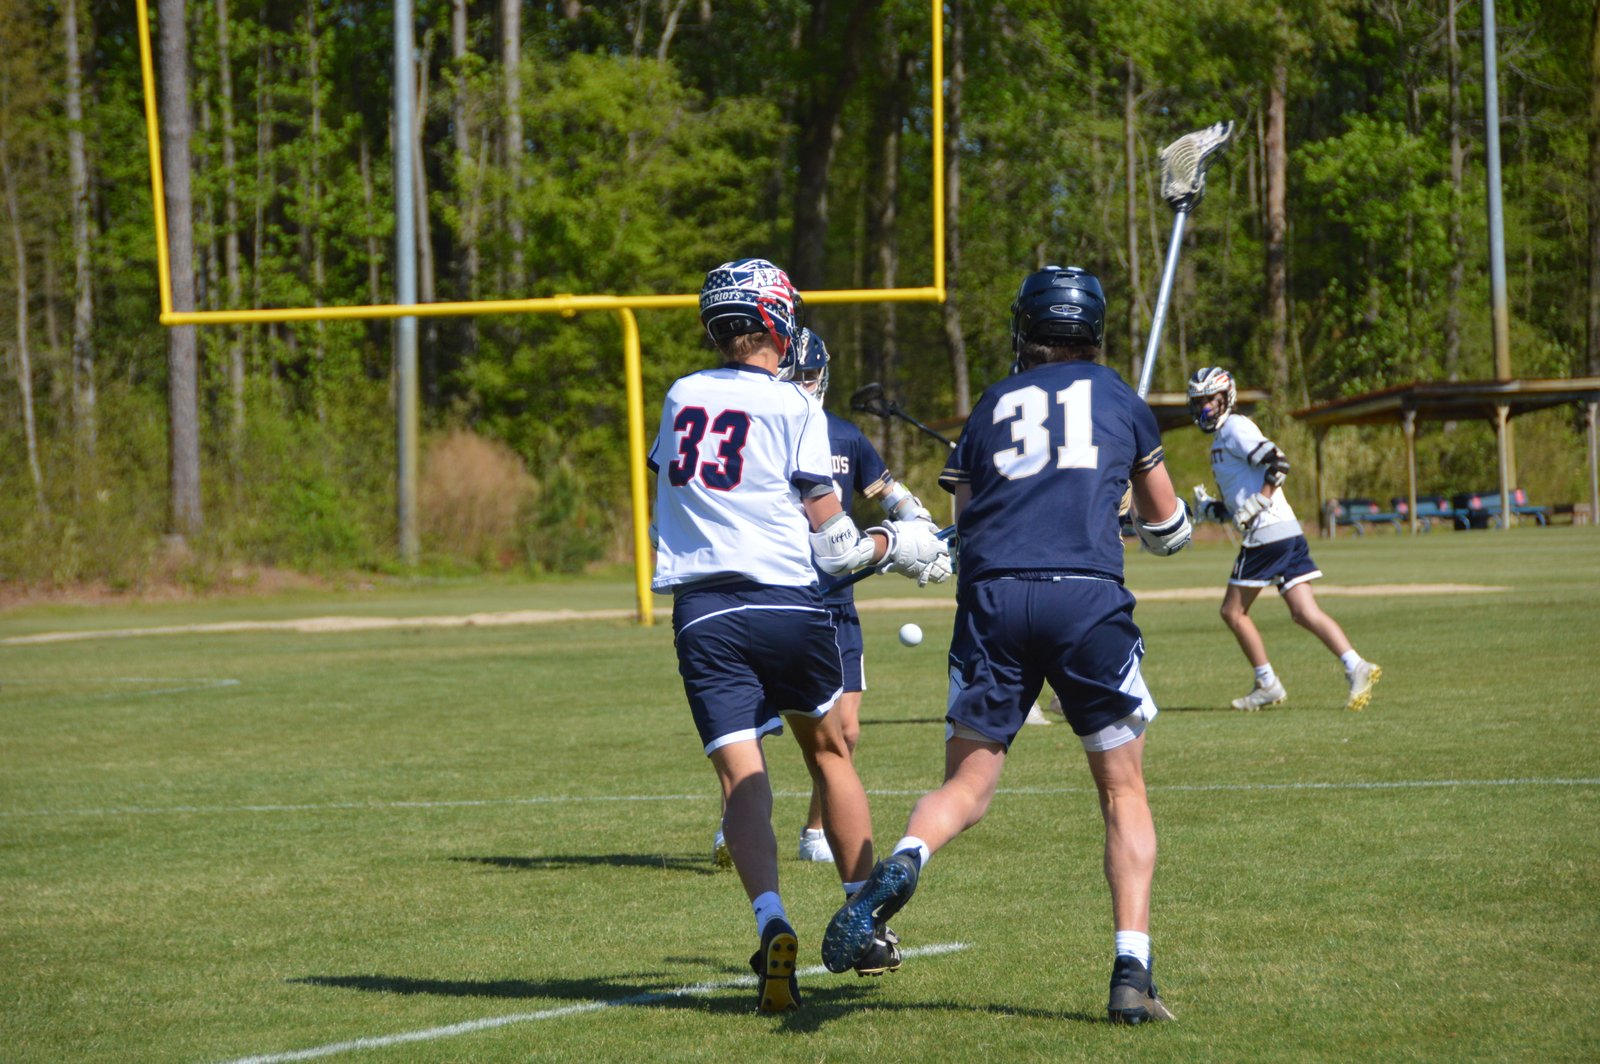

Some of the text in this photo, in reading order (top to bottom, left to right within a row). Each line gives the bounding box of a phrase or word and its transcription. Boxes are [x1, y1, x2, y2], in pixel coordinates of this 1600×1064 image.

[702, 291, 741, 308] PATRIOTS
[668, 405, 751, 491] 33
[992, 379, 1099, 480] 31
